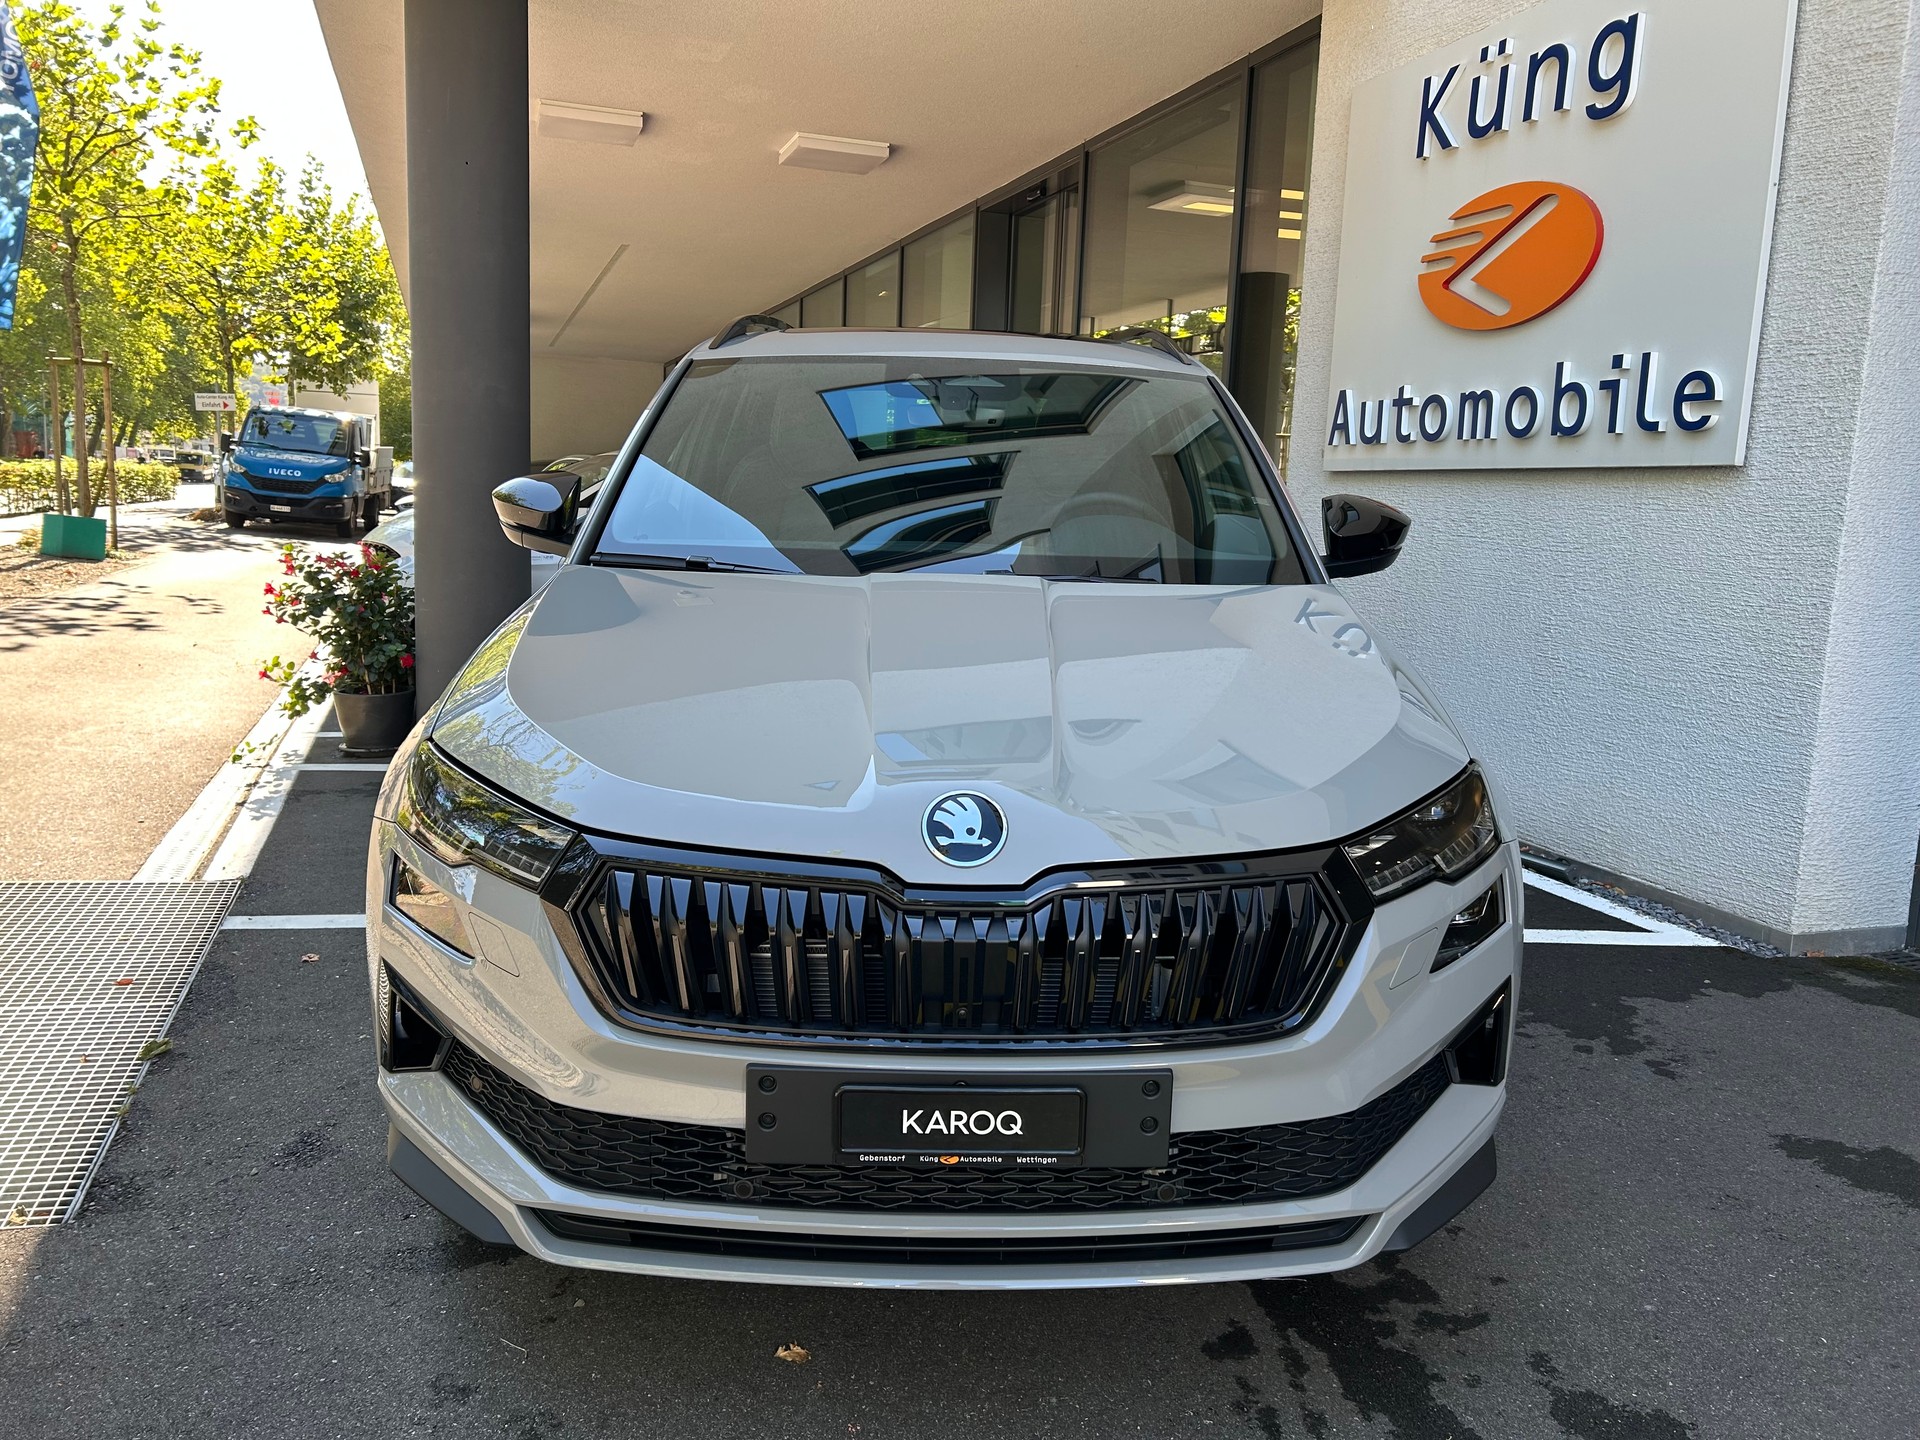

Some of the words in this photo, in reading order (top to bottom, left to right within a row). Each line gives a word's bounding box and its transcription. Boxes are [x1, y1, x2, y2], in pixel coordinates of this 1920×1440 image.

[1416, 11, 1645, 160] Küng
[1328, 351, 1722, 446] Automobile
[268, 467, 302, 477] IVECO
[902, 1109, 1024, 1135] KAROQ
[859, 1154, 906, 1162] Gebenstorf
[919, 1154, 939, 1163] Küng
[959, 1155, 1003, 1163] Automobile
[1016, 1155, 1058, 1165] Wettingen
